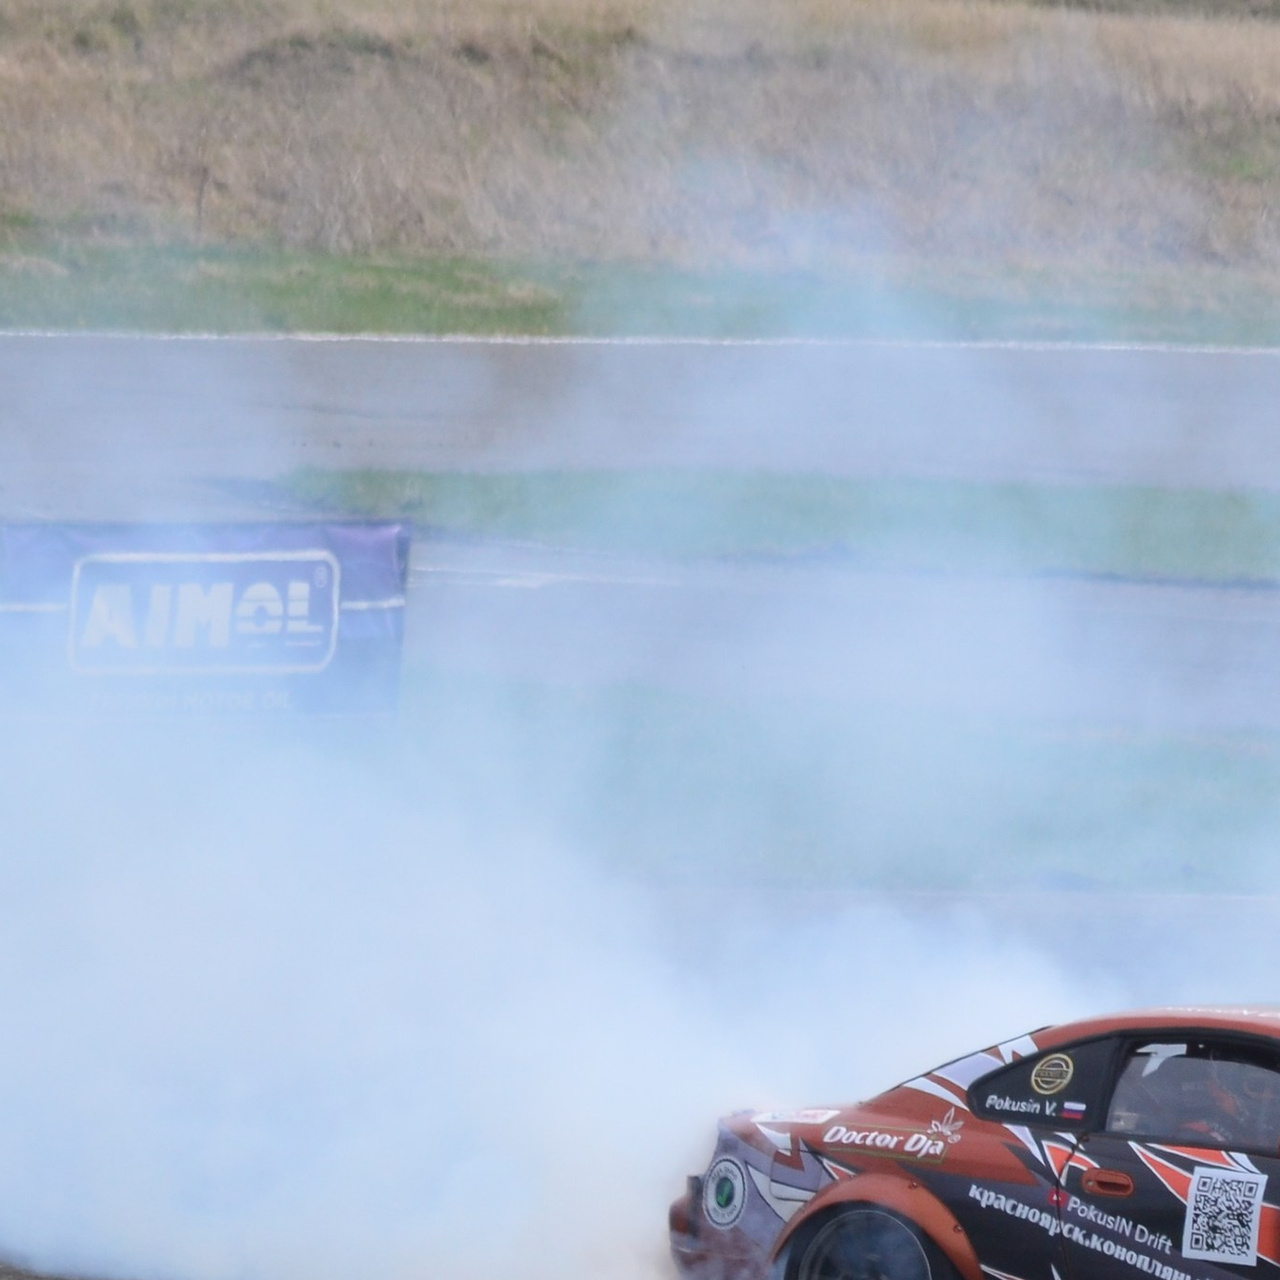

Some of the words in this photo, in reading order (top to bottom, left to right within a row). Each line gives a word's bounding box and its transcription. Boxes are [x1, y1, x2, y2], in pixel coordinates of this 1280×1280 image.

[81, 582, 324, 648] AIMOL
[985, 1095, 1040, 1114] Pokusin
[1045, 1100, 1057, 1116] V.
[823, 1125, 904, 1149] Doctor
[904, 1133, 945, 1158] Dja
[1067, 1196, 1133, 1237] PokusIN
[1134, 1223, 1173, 1255] Drift
